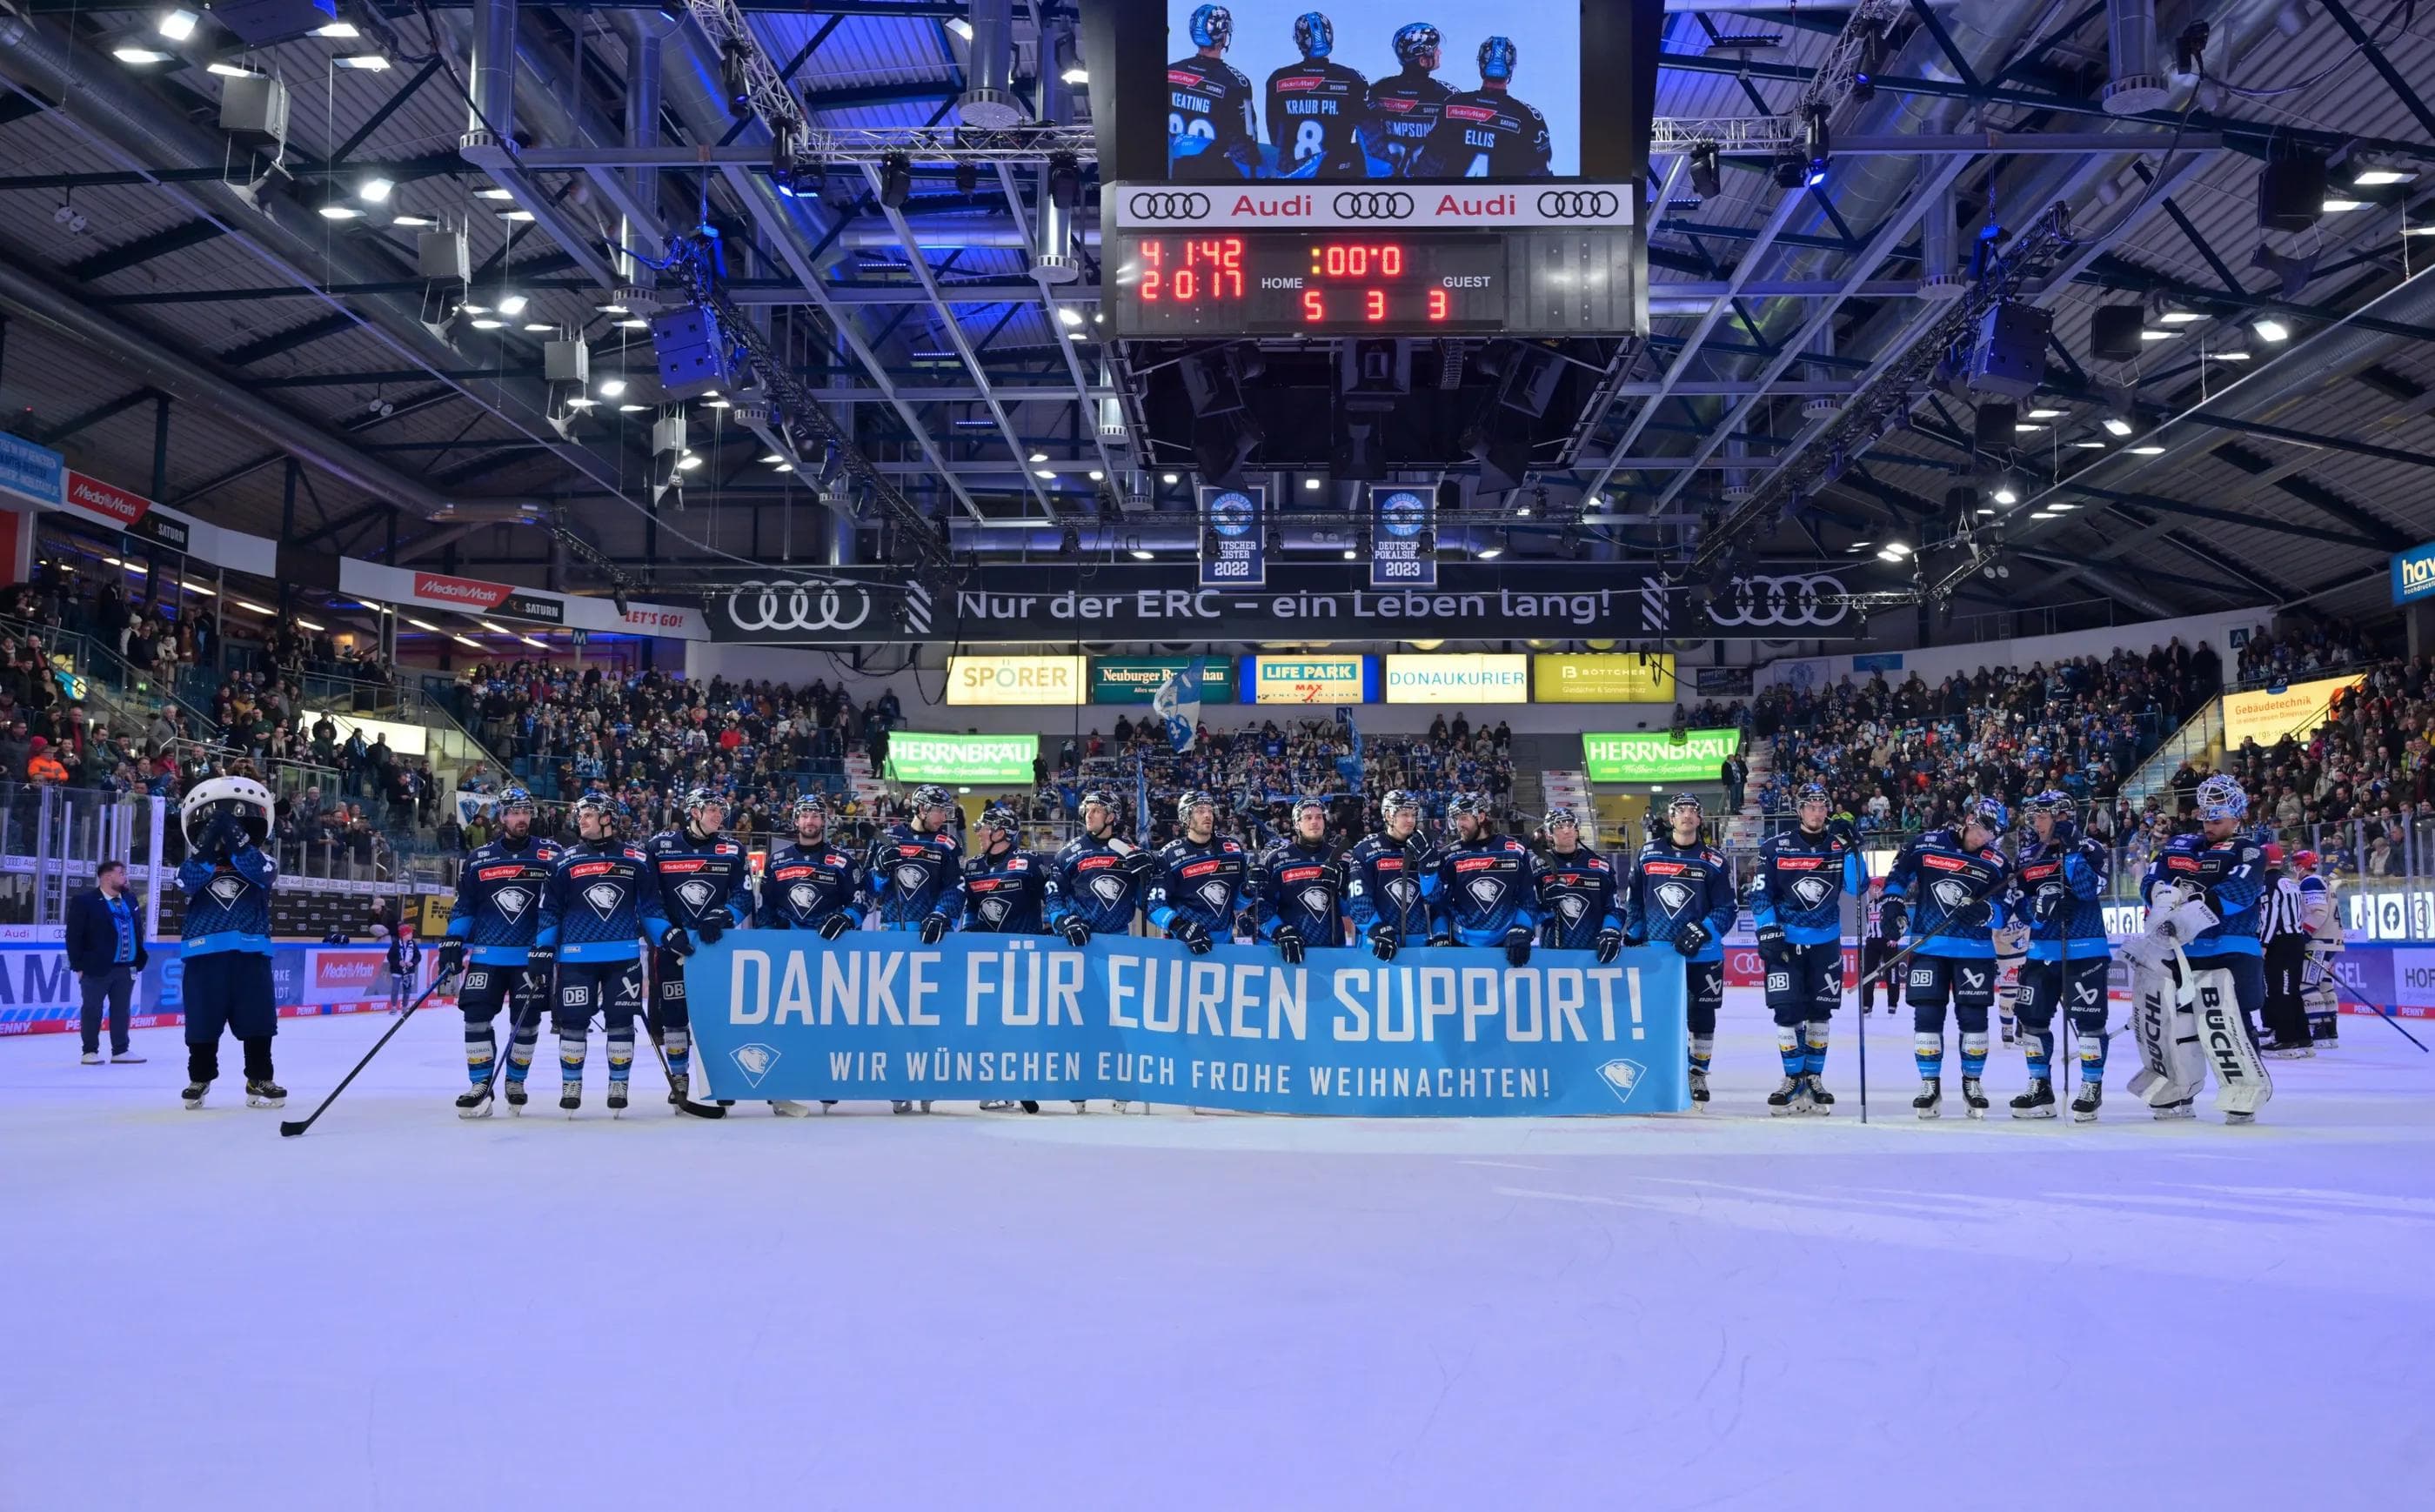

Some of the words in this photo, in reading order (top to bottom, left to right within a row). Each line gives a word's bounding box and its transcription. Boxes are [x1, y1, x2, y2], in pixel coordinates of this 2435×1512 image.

[1172, 91, 1211, 114] KEATING
[1321, 100, 1339, 115] PH.
[1465, 130, 1495, 148] ELLIS
[1231, 195, 1312, 217] Audi
[1435, 194, 1515, 216] Audi
[1261, 277, 1303, 291] HOME
[1442, 276, 1491, 290] GUEST
[1304, 291, 1322, 320] 5
[1368, 291, 1385, 319] 3
[1430, 291, 1447, 319] 3
[158, 523, 185, 545] SATURN
[1220, 541, 1256, 551] UTSCHER
[1378, 541, 1420, 551] DEUTSCH
[1221, 550, 1250, 559] EISTER
[1375, 550, 1420, 560] POKALSIE
[1214, 561, 1249, 576] 2022
[1385, 562, 1421, 576] 2023
[525, 602, 559, 618] SATURN
[958, 592, 1037, 619] Nur
[1049, 590, 1121, 619] der
[1137, 591, 1222, 619] ERC
[1272, 590, 1337, 618] ein
[1354, 590, 1483, 619] Leben
[1501, 590, 1610, 624] lang!
[625, 610, 658, 626] LET'S
[659, 612, 683, 627] GO!
[572, 631, 587, 646] M
[2232, 632, 2247, 646] A
[963, 659, 1067, 687] SPÖRER
[1103, 668, 1159, 684] Neuburger
[1267, 666, 1300, 679] LIFE
[1303, 666, 1352, 679] PARK
[1389, 672, 1525, 686] DONAUKURIER
[1582, 667, 1646, 676] BÖTTCHER
[2234, 696, 2312, 715] Gebäudetechnik
[2279, 709, 2313, 719] Dimension
[890, 740, 1032, 764] HERRNBRÄU
[1589, 738, 1734, 761] HERRNBRÄU
[1348, 879, 1364, 898] 16
[4, 928, 30, 939] Audi
[467, 974, 485, 988] DB
[1768, 974, 1787, 990] DB
[1912, 972, 1930, 986] DB
[566, 988, 585, 1004] DB
[667, 982, 685, 996] DB
[729, 949, 941, 1027] DANKE
[965, 940, 1085, 1027] FÜR
[1107, 954, 1308, 1041] EUREN
[1333, 967, 1644, 1042] SUPPORT!
[0, 1021, 33, 1034] ENNY.
[2144, 990, 2169, 1079] BÜCHL
[2200, 987, 2244, 1085] BÜCHL
[829, 1051, 887, 1081] WIR
[906, 1047, 1080, 1082] WÜNSCHEN
[1097, 1051, 1174, 1086] EUCH
[1192, 1060, 1291, 1094] FROHE
[1309, 1067, 1549, 1098] WEIHNACHTEN!
